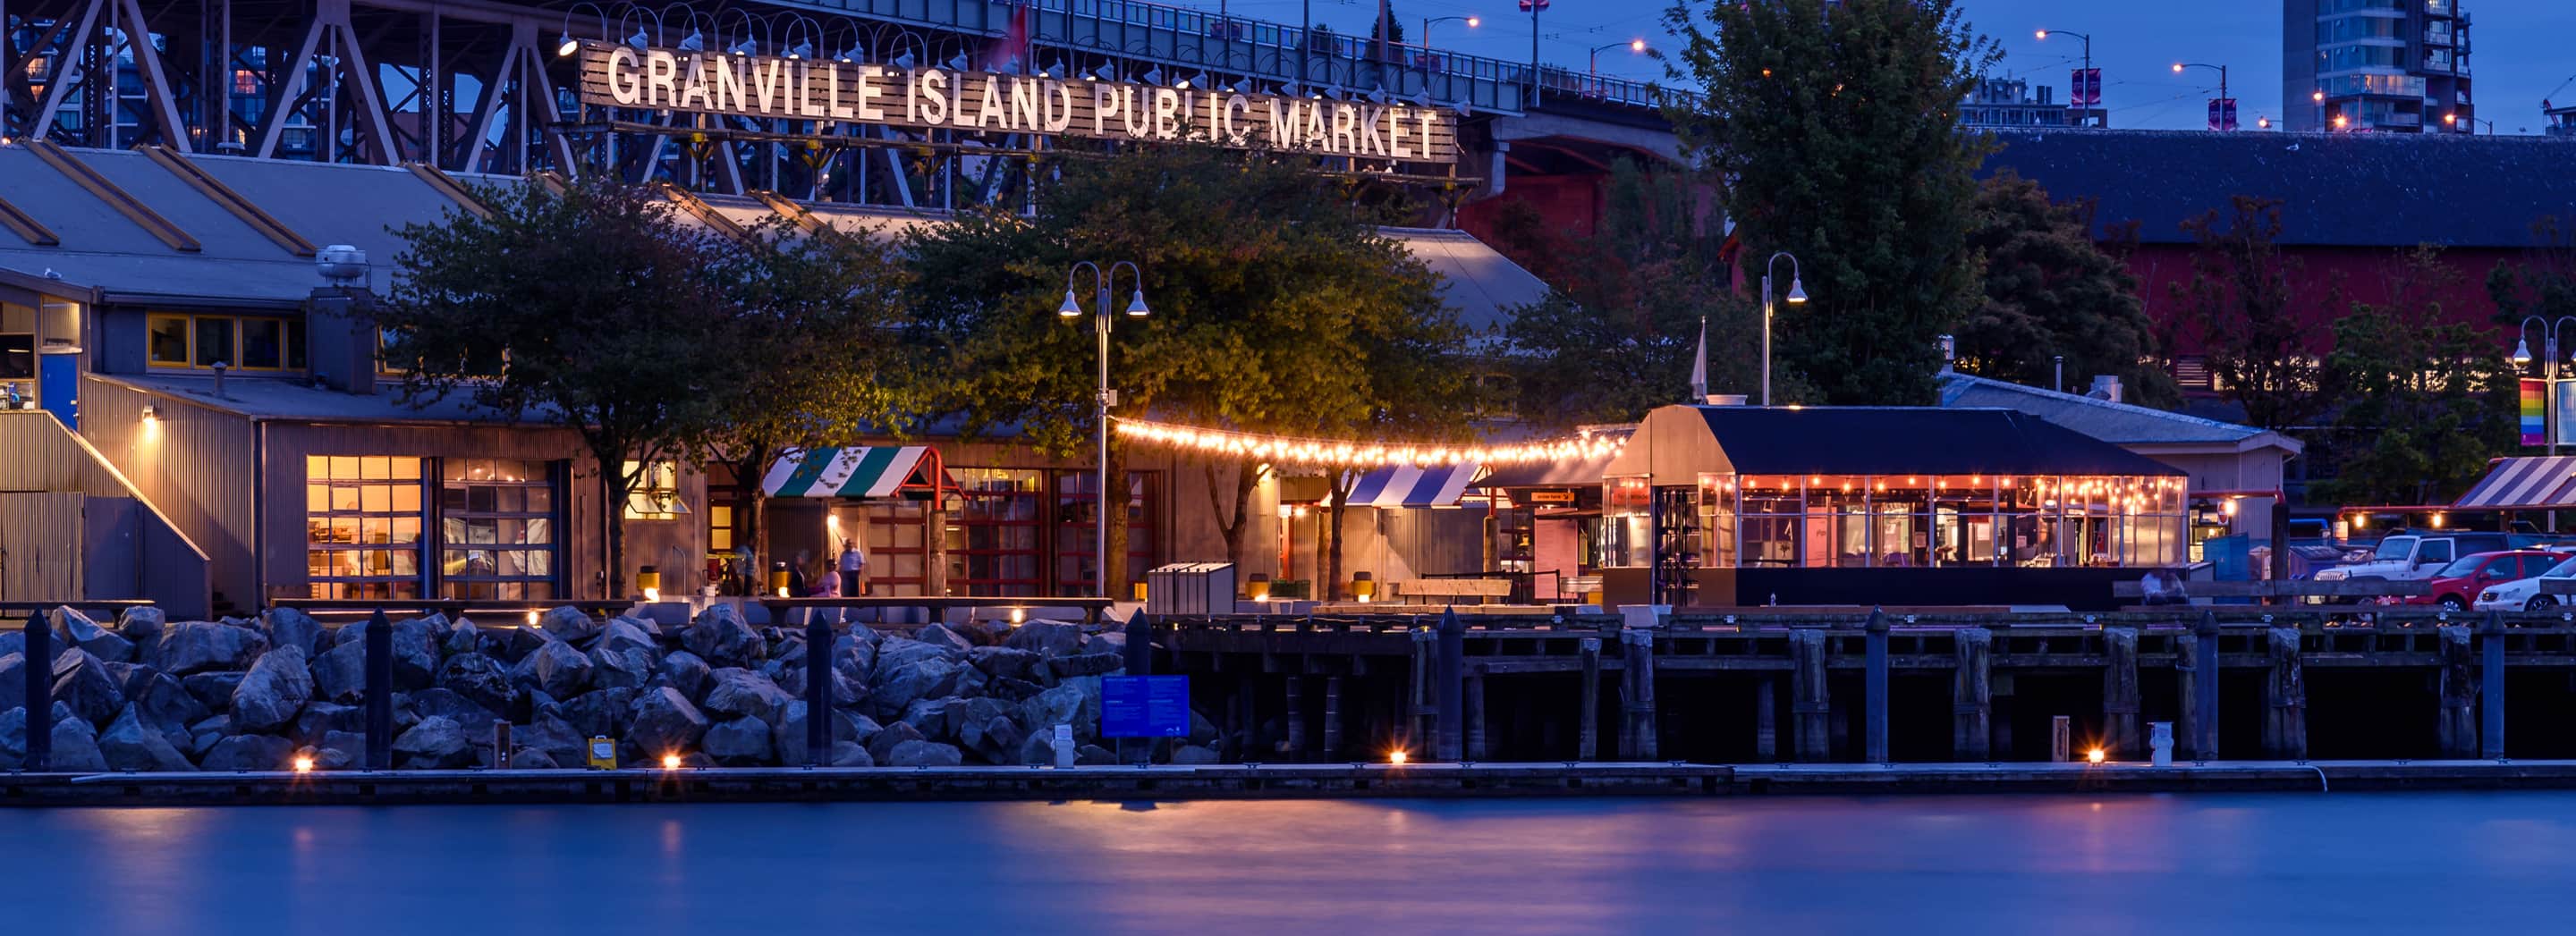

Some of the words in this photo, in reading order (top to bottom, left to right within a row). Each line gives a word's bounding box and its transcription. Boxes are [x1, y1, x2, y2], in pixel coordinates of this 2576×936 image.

[607, 46, 883, 120] GRANVILLE
[907, 69, 1071, 132] ISLAND
[1096, 83, 1250, 146] PUBLIC
[1270, 98, 1436, 158] MARKET
